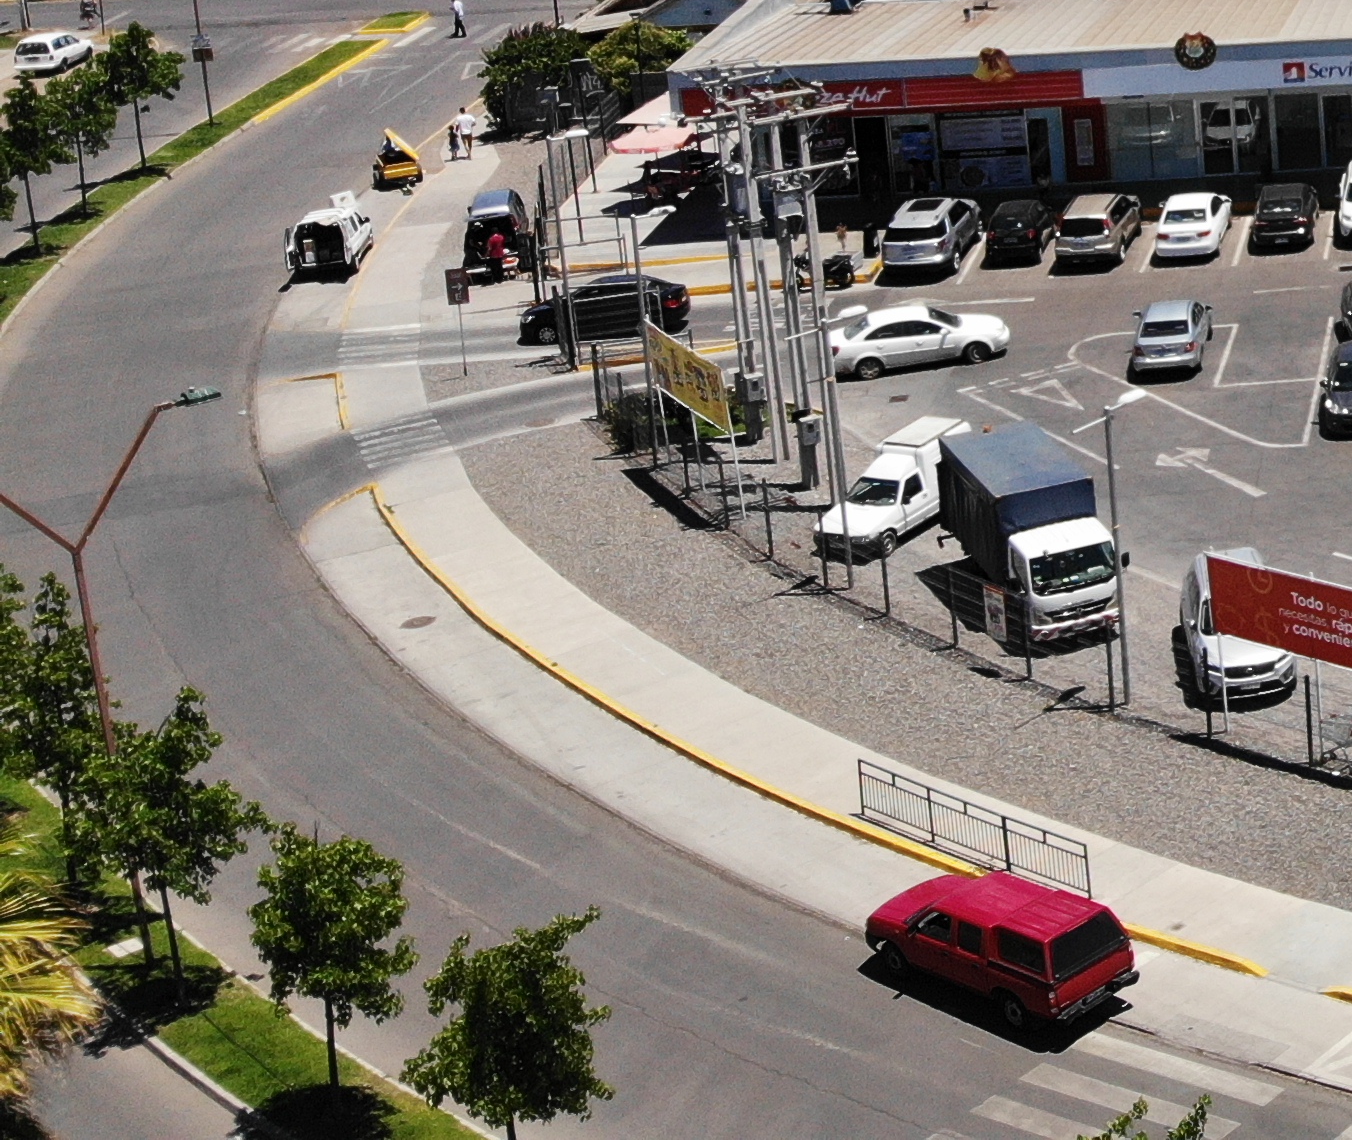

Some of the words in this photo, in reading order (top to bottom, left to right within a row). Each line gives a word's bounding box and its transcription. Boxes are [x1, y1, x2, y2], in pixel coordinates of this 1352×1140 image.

[1290, 591, 1323, 611] Todo
[1327, 602, 1337, 615] lo
[1283, 623, 1291, 634] y
